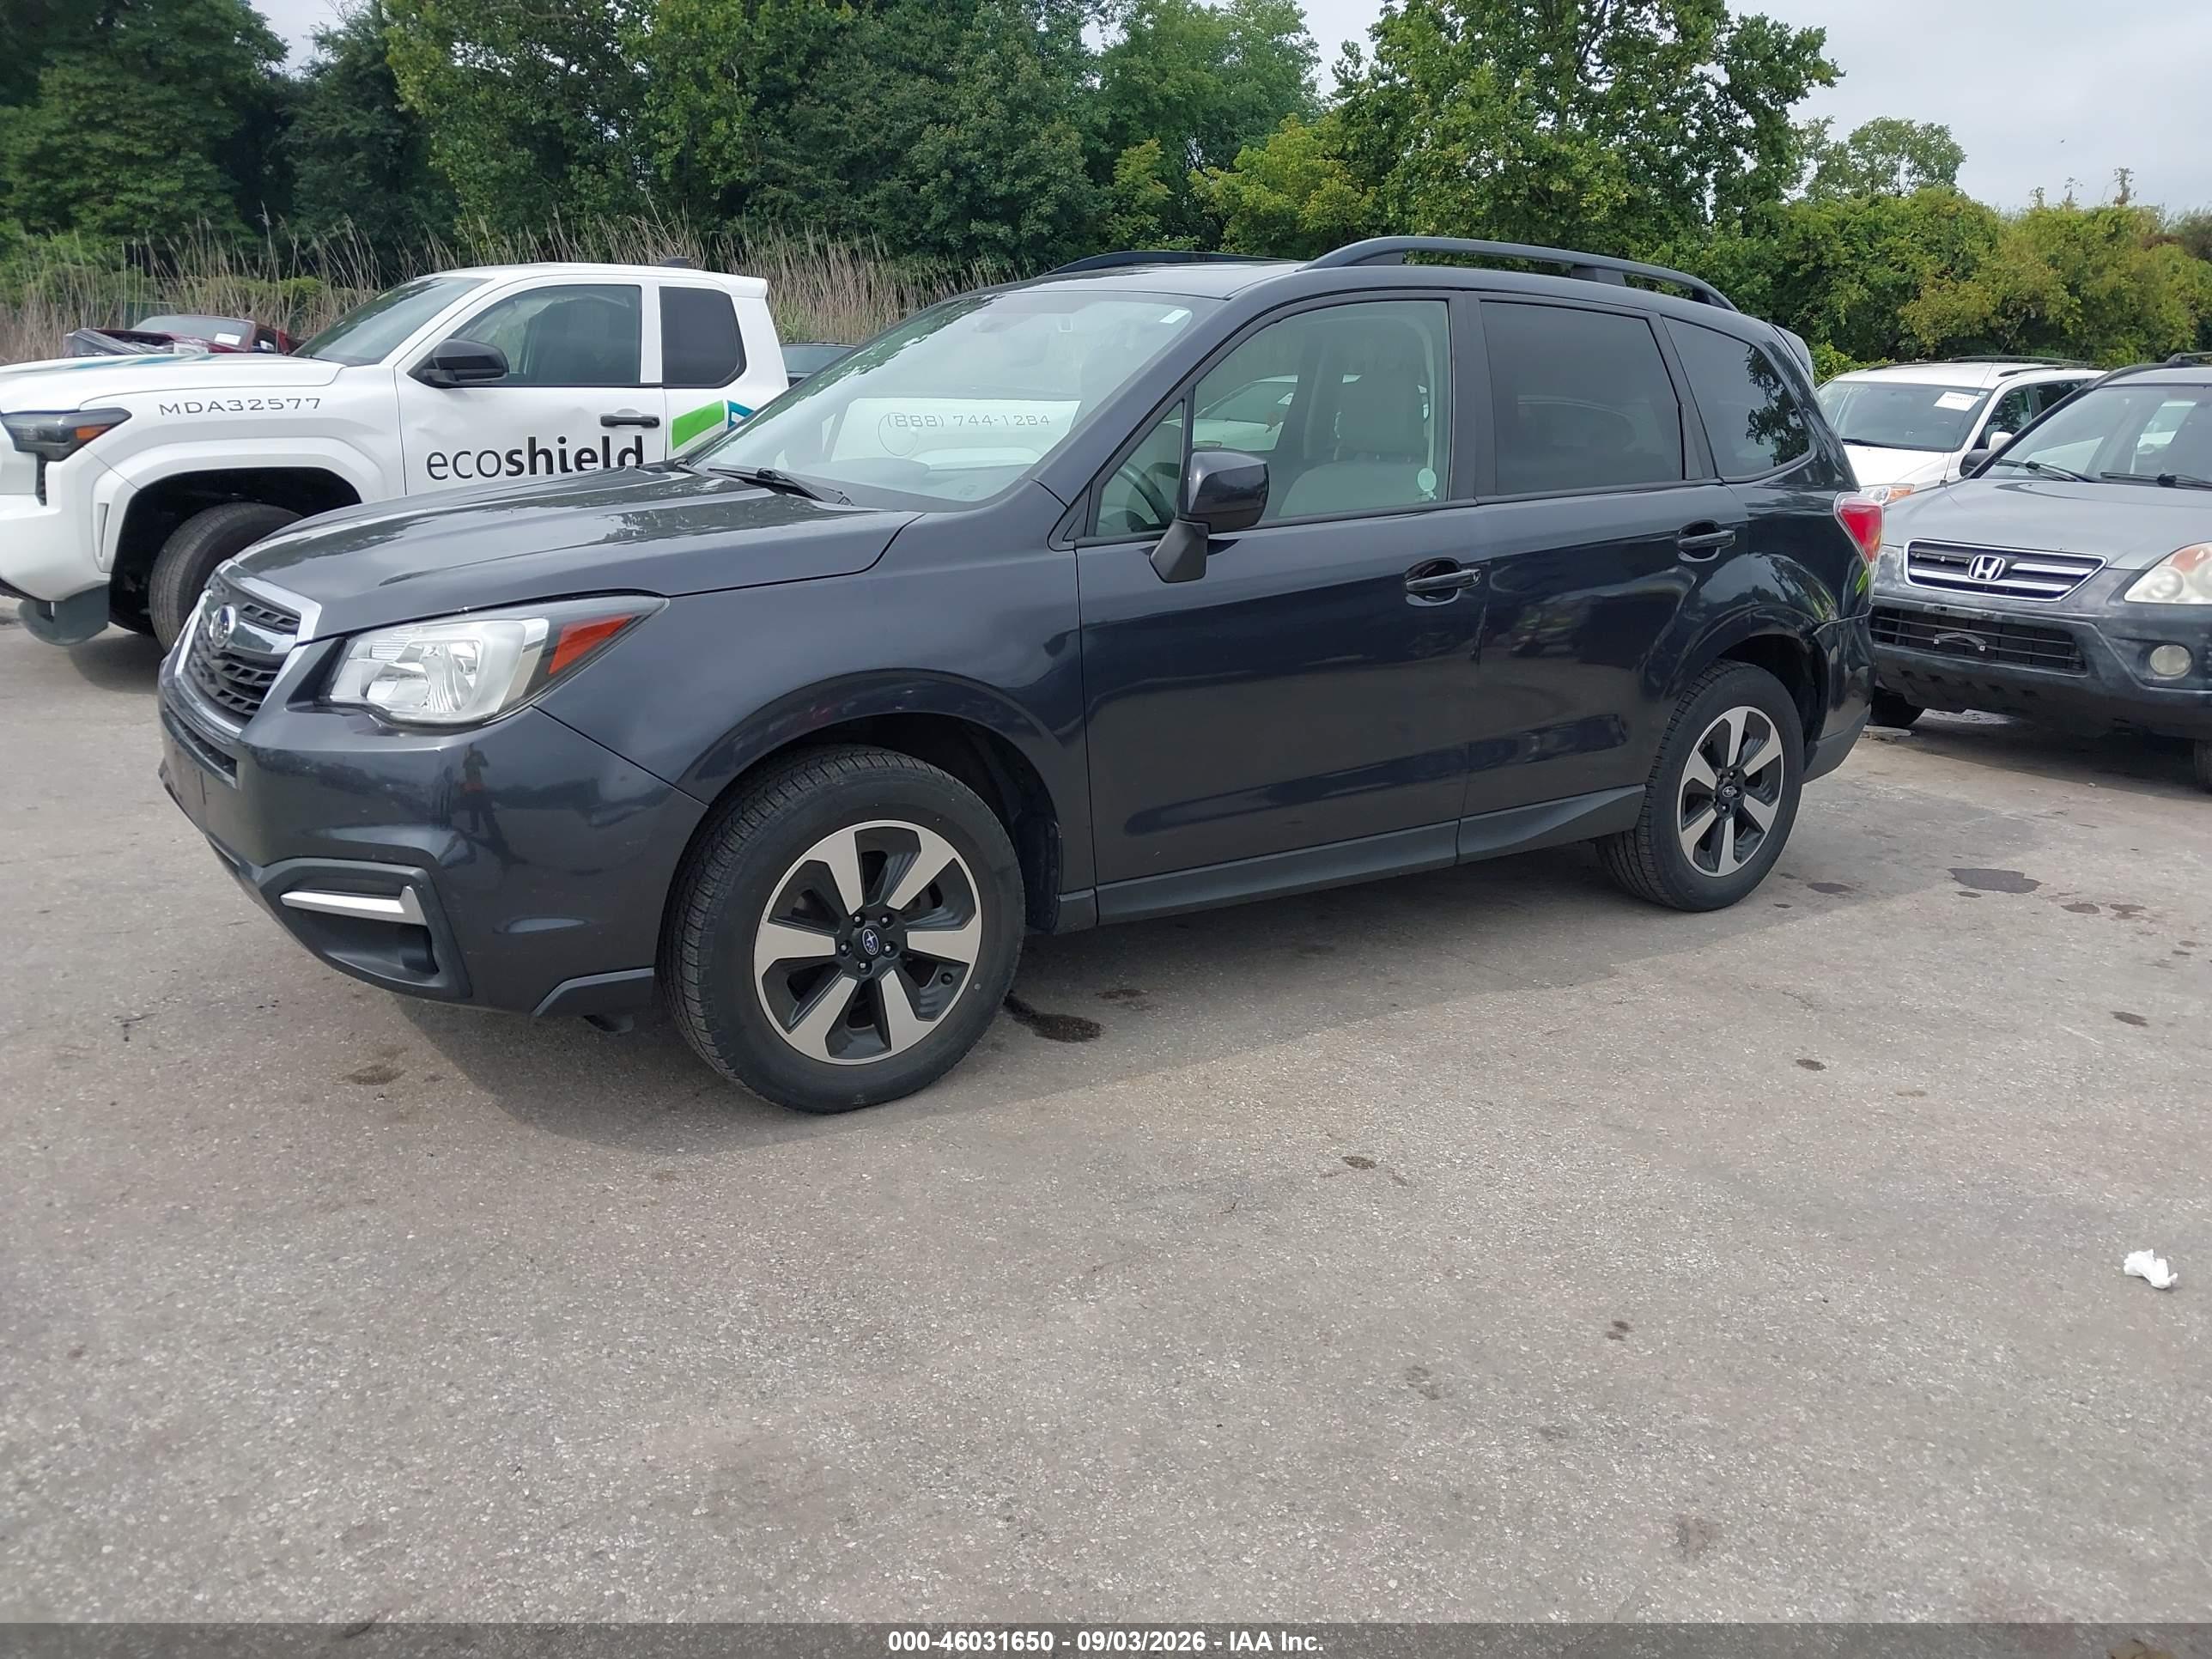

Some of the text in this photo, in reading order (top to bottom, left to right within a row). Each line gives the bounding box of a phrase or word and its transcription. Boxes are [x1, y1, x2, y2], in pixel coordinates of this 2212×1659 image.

[158, 398, 321, 416] MDA32577
[887, 414, 1052, 428] (888) 744-1284
[426, 434, 644, 481] ecoshield
